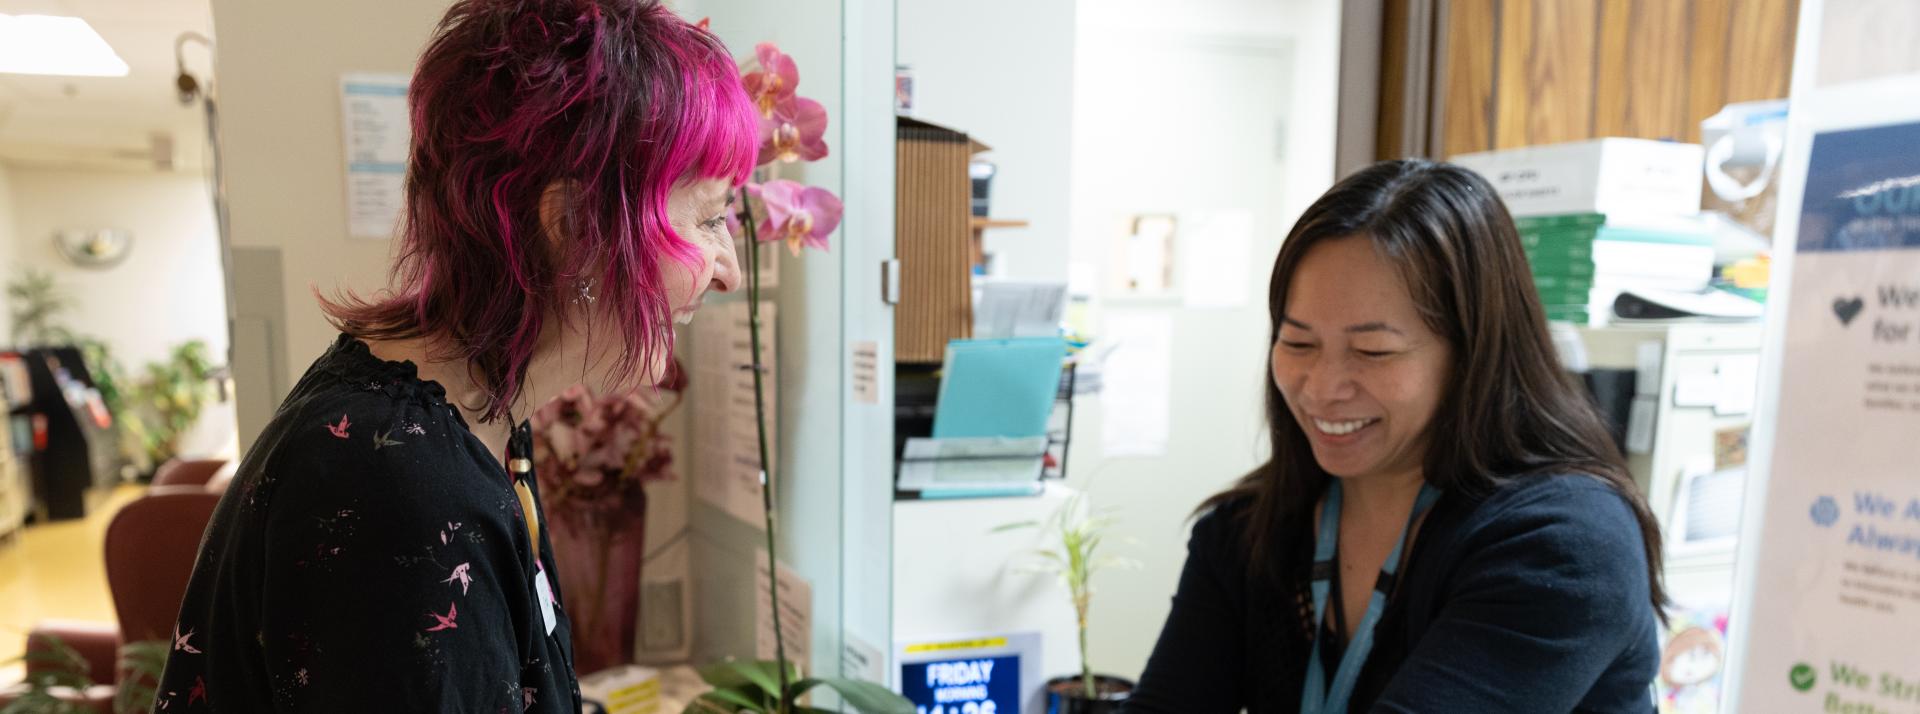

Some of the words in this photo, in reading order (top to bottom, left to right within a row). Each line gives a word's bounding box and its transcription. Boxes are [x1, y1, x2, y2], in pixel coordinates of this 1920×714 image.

[1873, 317, 1908, 342] for
[1853, 491, 1896, 518] We
[926, 660, 994, 687] FRIDAY
[1829, 660, 1871, 690] We
[934, 684, 988, 703] MORNING
